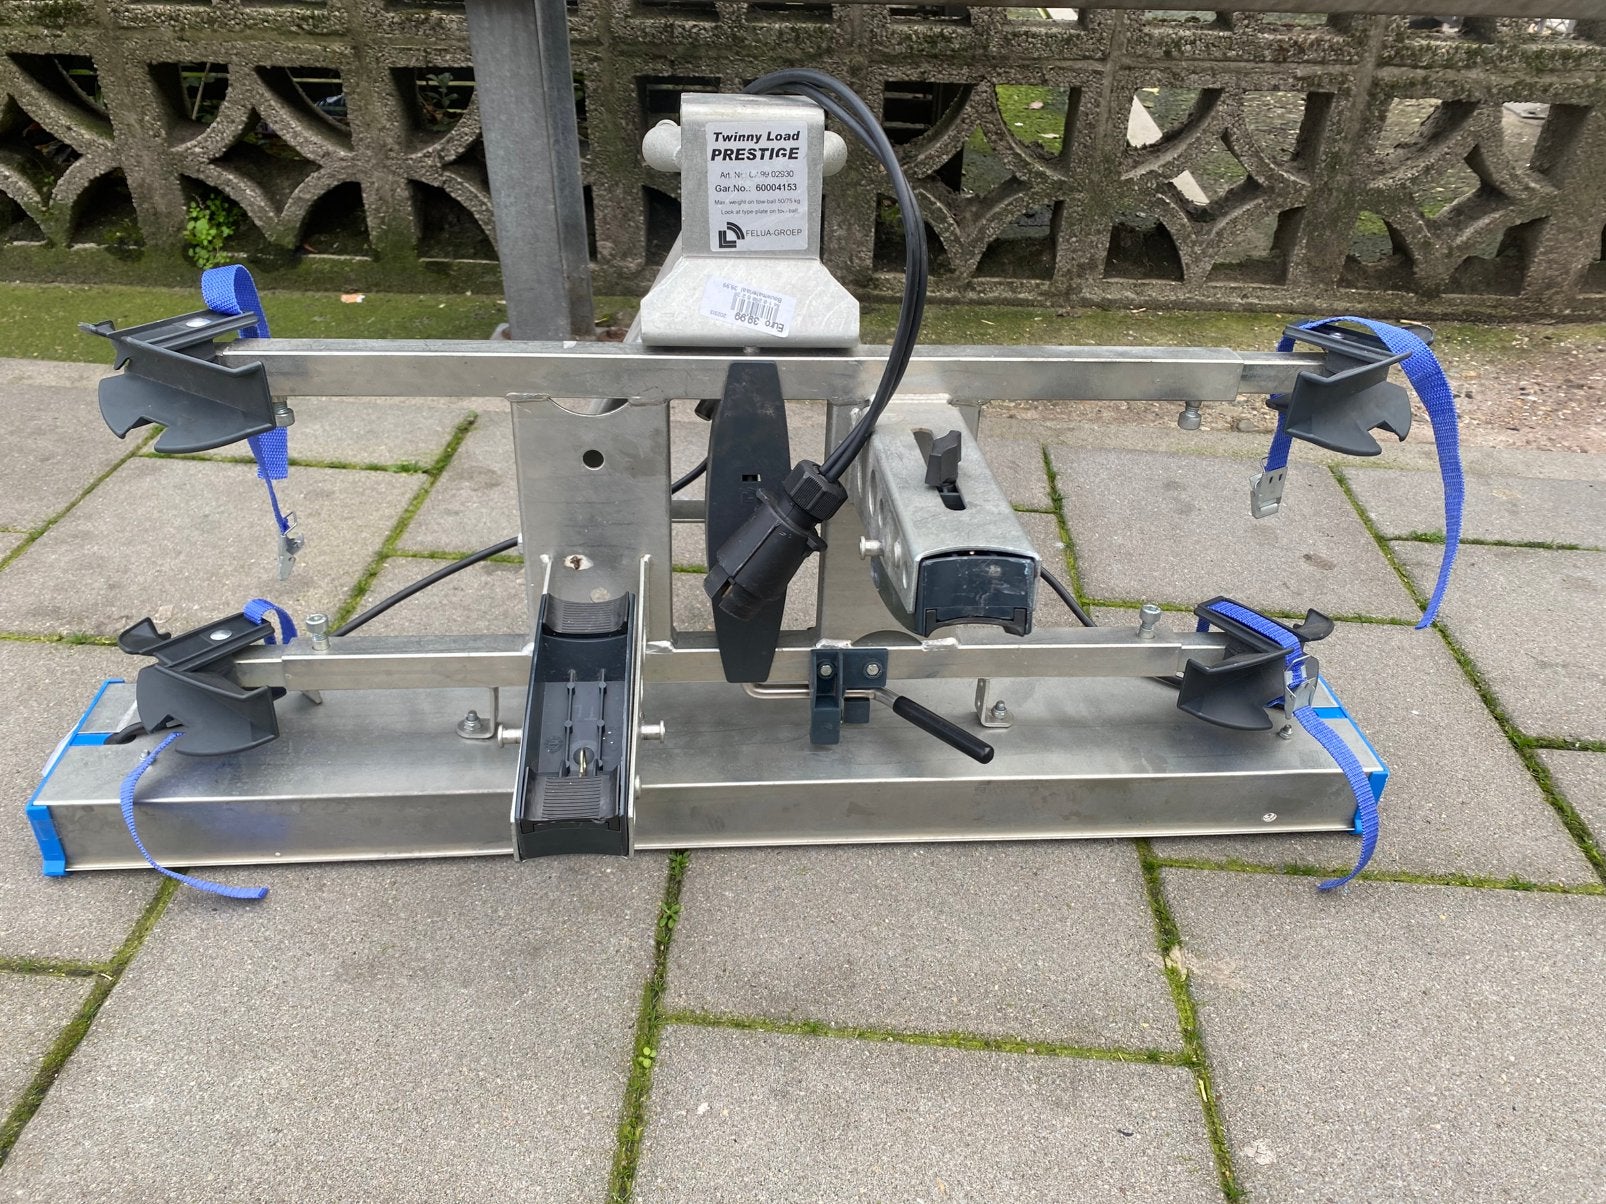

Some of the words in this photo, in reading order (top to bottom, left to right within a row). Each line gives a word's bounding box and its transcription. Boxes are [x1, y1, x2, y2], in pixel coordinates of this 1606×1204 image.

[713, 132, 762, 144] Twinny
[766, 131, 800, 142] Load
[711, 147, 799, 161] PRESTIGE
[755, 183, 797, 192] 60004153
[745, 229, 802, 237] FELUA-GROEP
[765, 320, 785, 333] Euro
